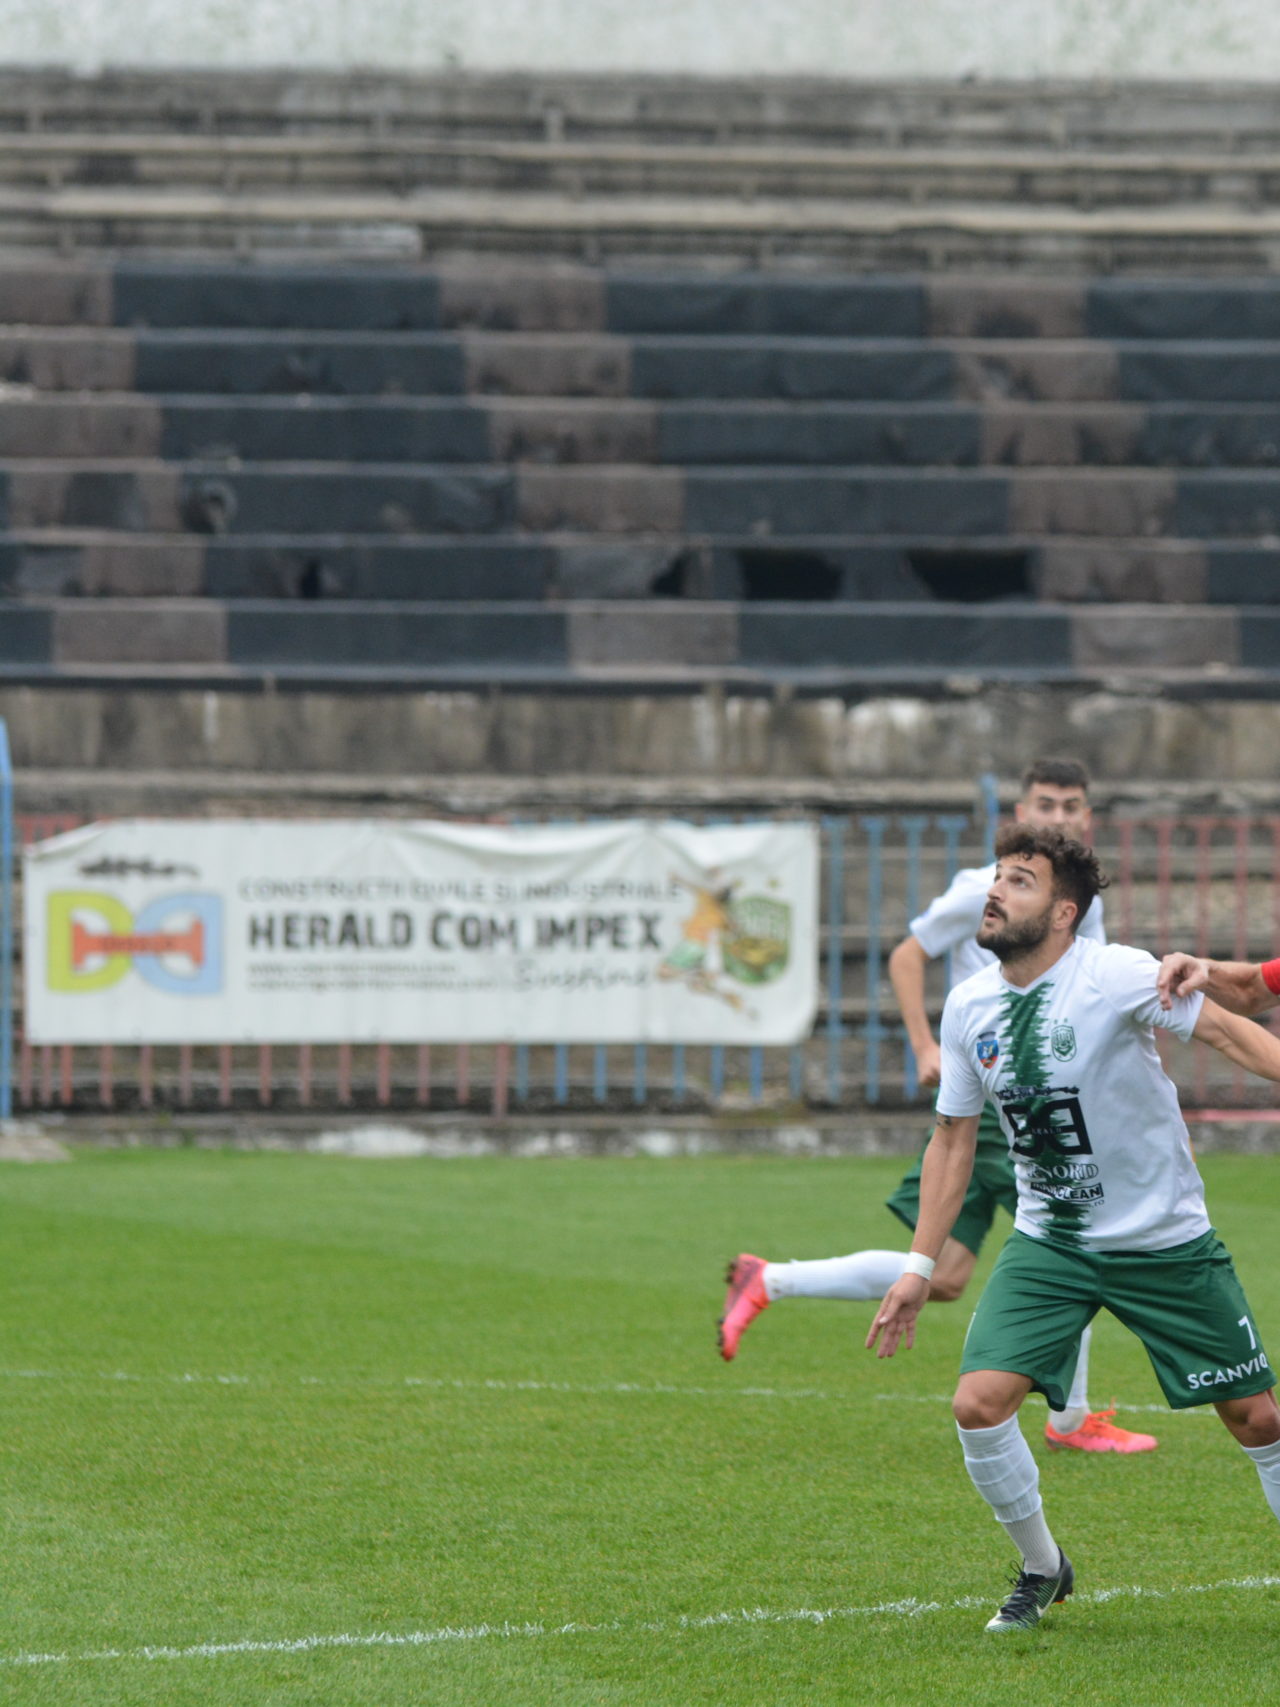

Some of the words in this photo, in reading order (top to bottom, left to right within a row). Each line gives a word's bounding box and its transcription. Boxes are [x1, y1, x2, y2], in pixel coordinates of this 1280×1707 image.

[249, 911, 413, 950] HERALD
[431, 911, 518, 950] COM
[536, 912, 661, 950] IMPEX
[1238, 1315, 1257, 1350] 7
